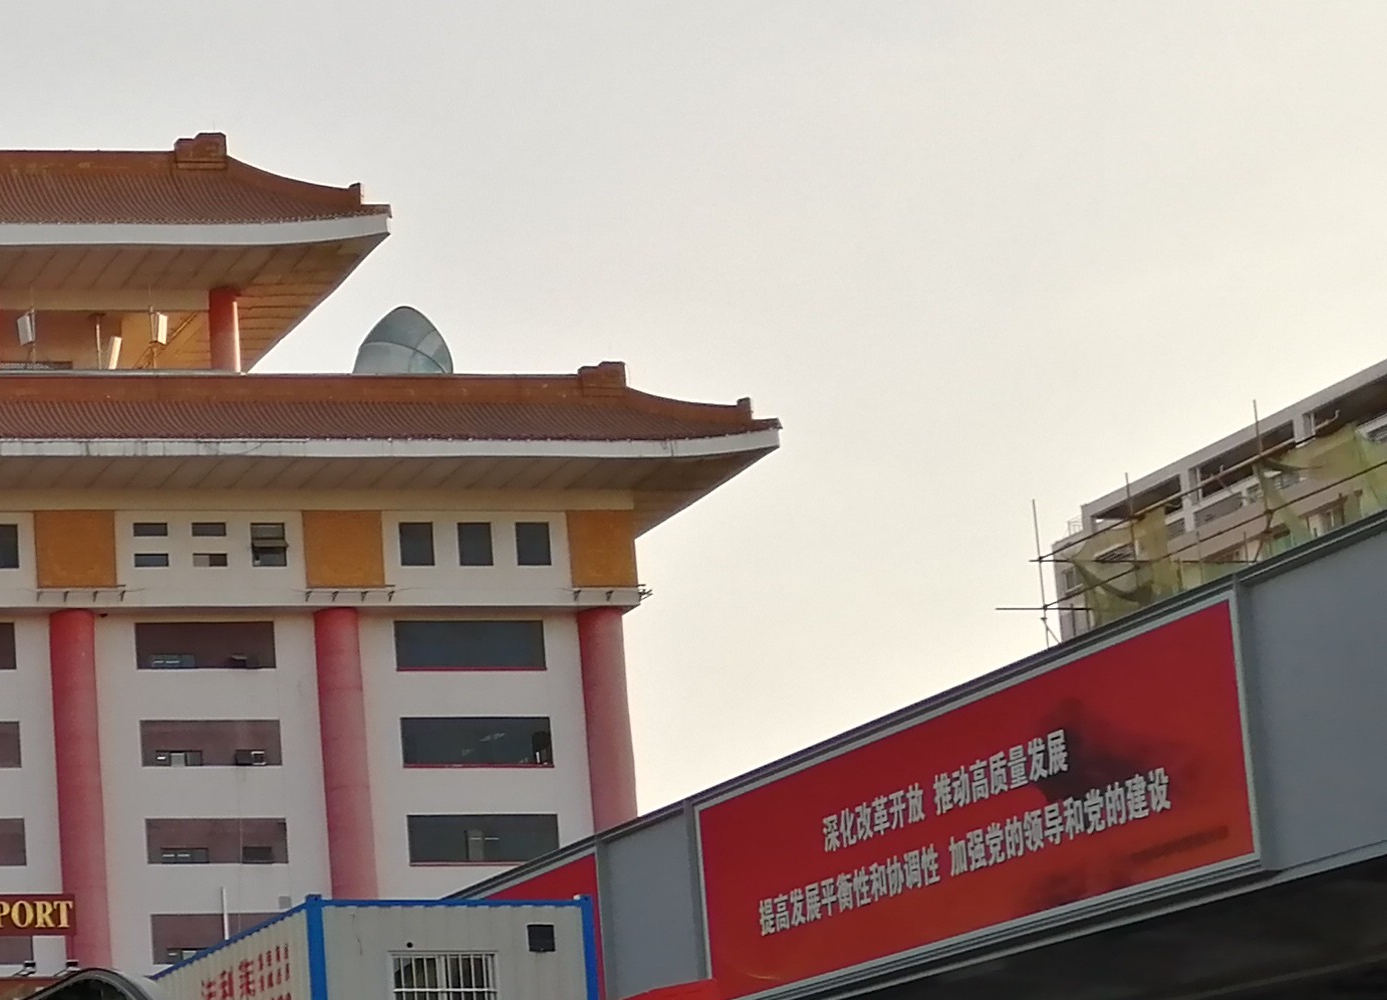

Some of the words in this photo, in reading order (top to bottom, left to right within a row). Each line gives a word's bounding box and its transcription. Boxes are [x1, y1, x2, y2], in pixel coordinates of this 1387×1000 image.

[758, 843, 941, 937] 提高发展平衡性和协调性
[949, 767, 1172, 877] 加强党的领导和党的建设
[822, 783, 926, 852] 深化改革开放
[933, 729, 1069, 816] 推动高质量发展
